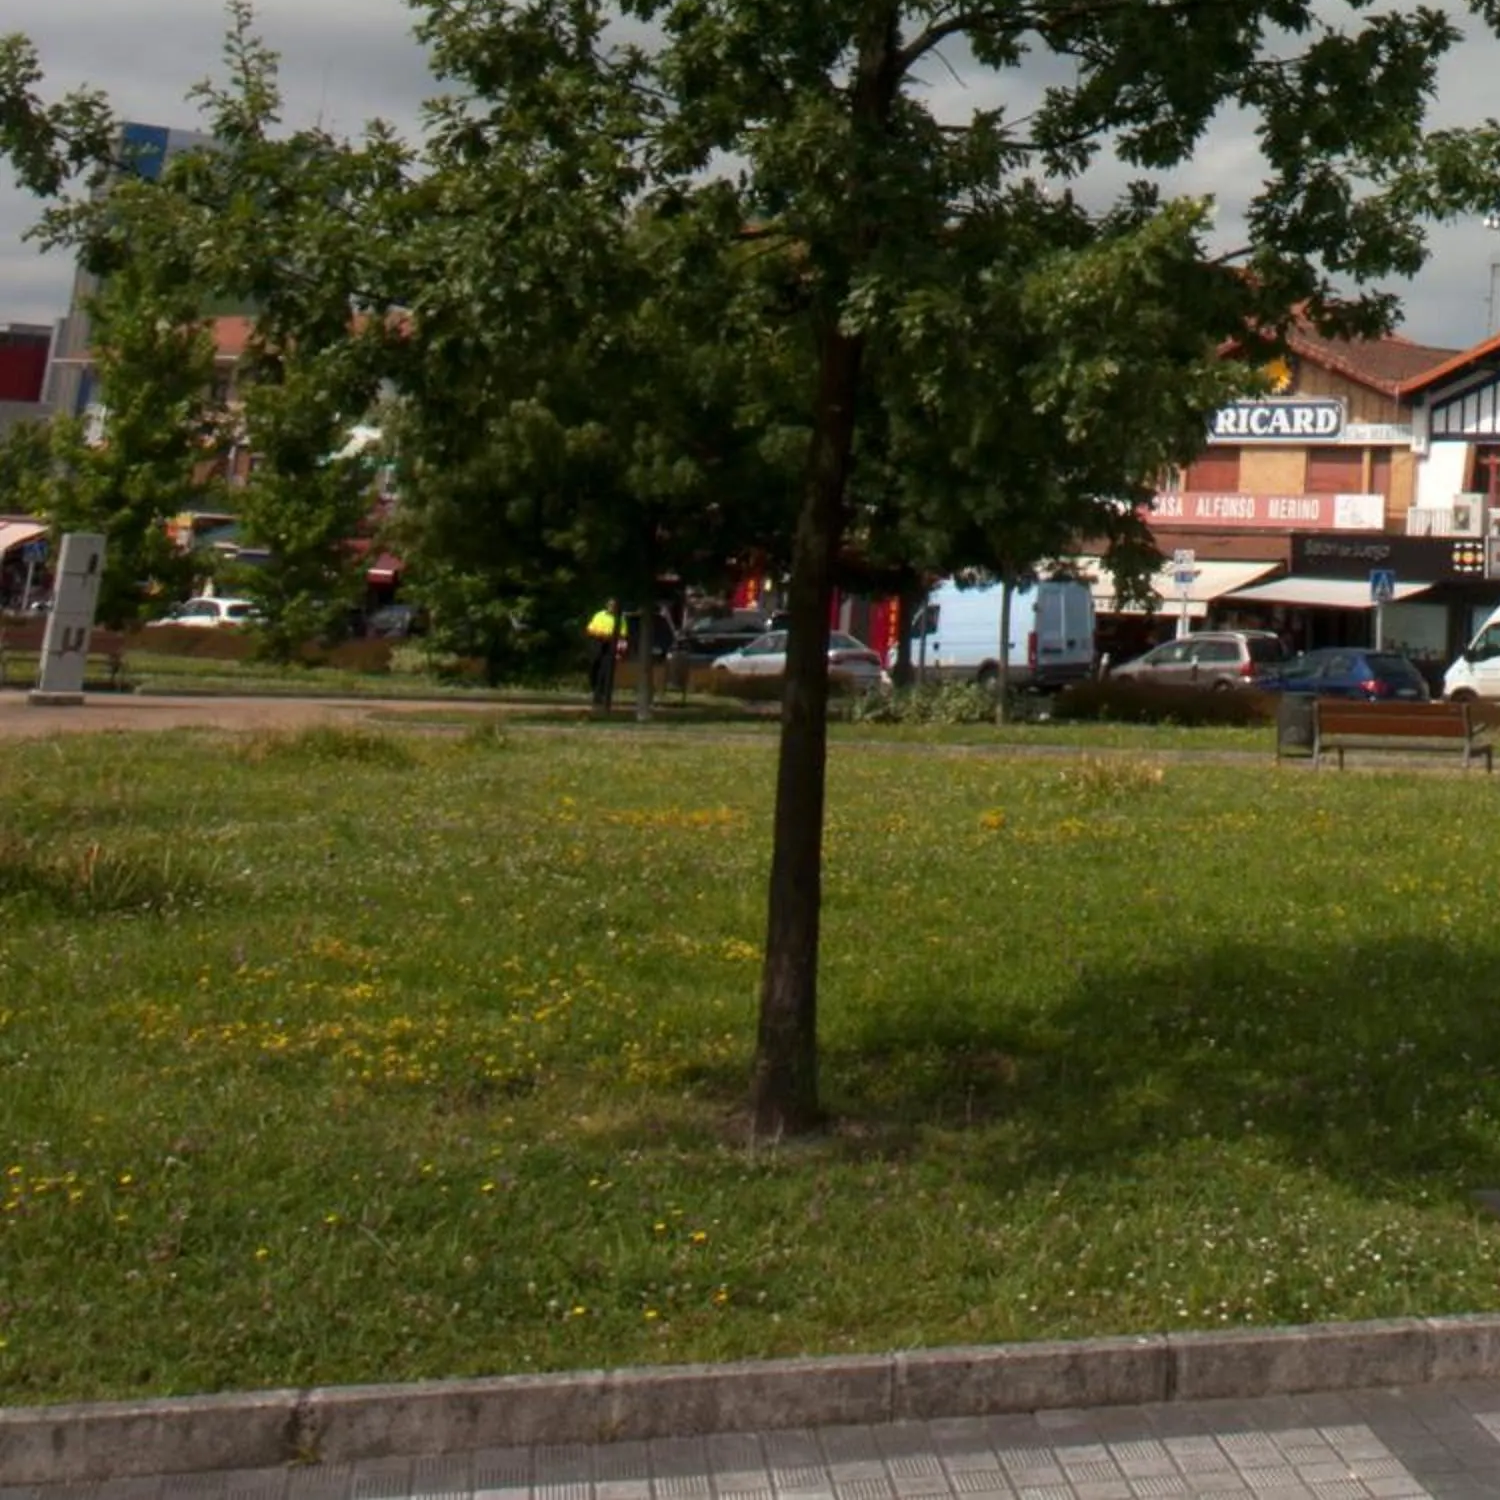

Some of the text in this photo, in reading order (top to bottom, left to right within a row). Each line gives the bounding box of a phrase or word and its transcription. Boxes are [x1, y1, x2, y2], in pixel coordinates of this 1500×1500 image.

[1215, 407, 1338, 435] RICARD
[1151, 496, 1320, 520] CASA ALFONSO MERINO
